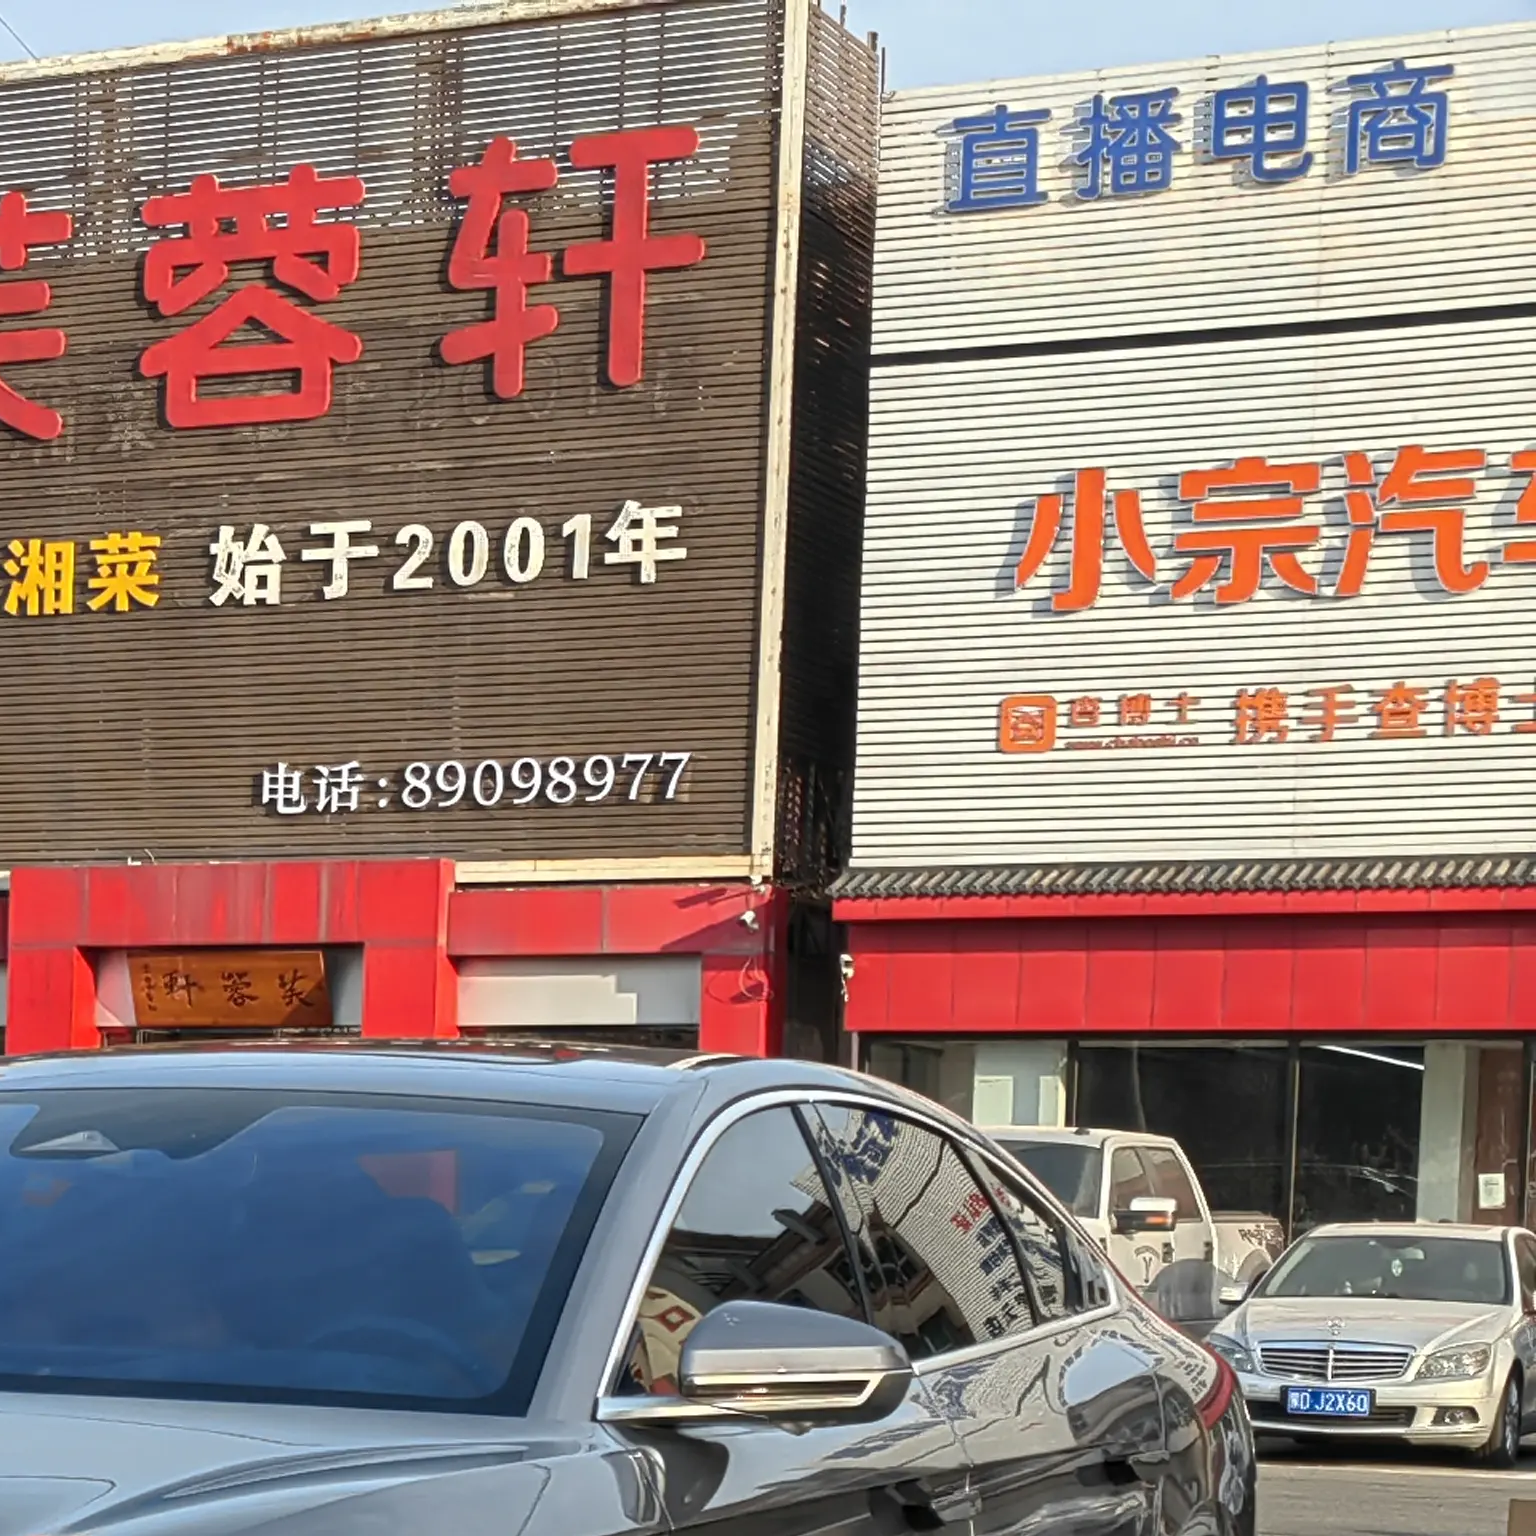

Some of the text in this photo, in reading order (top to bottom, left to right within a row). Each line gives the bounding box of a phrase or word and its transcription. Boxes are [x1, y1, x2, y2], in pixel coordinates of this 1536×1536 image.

[947, 58, 1456, 213] 直播电商
[208, 499, 688, 608] 始于2001年
[1014, 443, 1536, 613] 小宗汽
[260, 750, 693, 818] 电话:89098977
